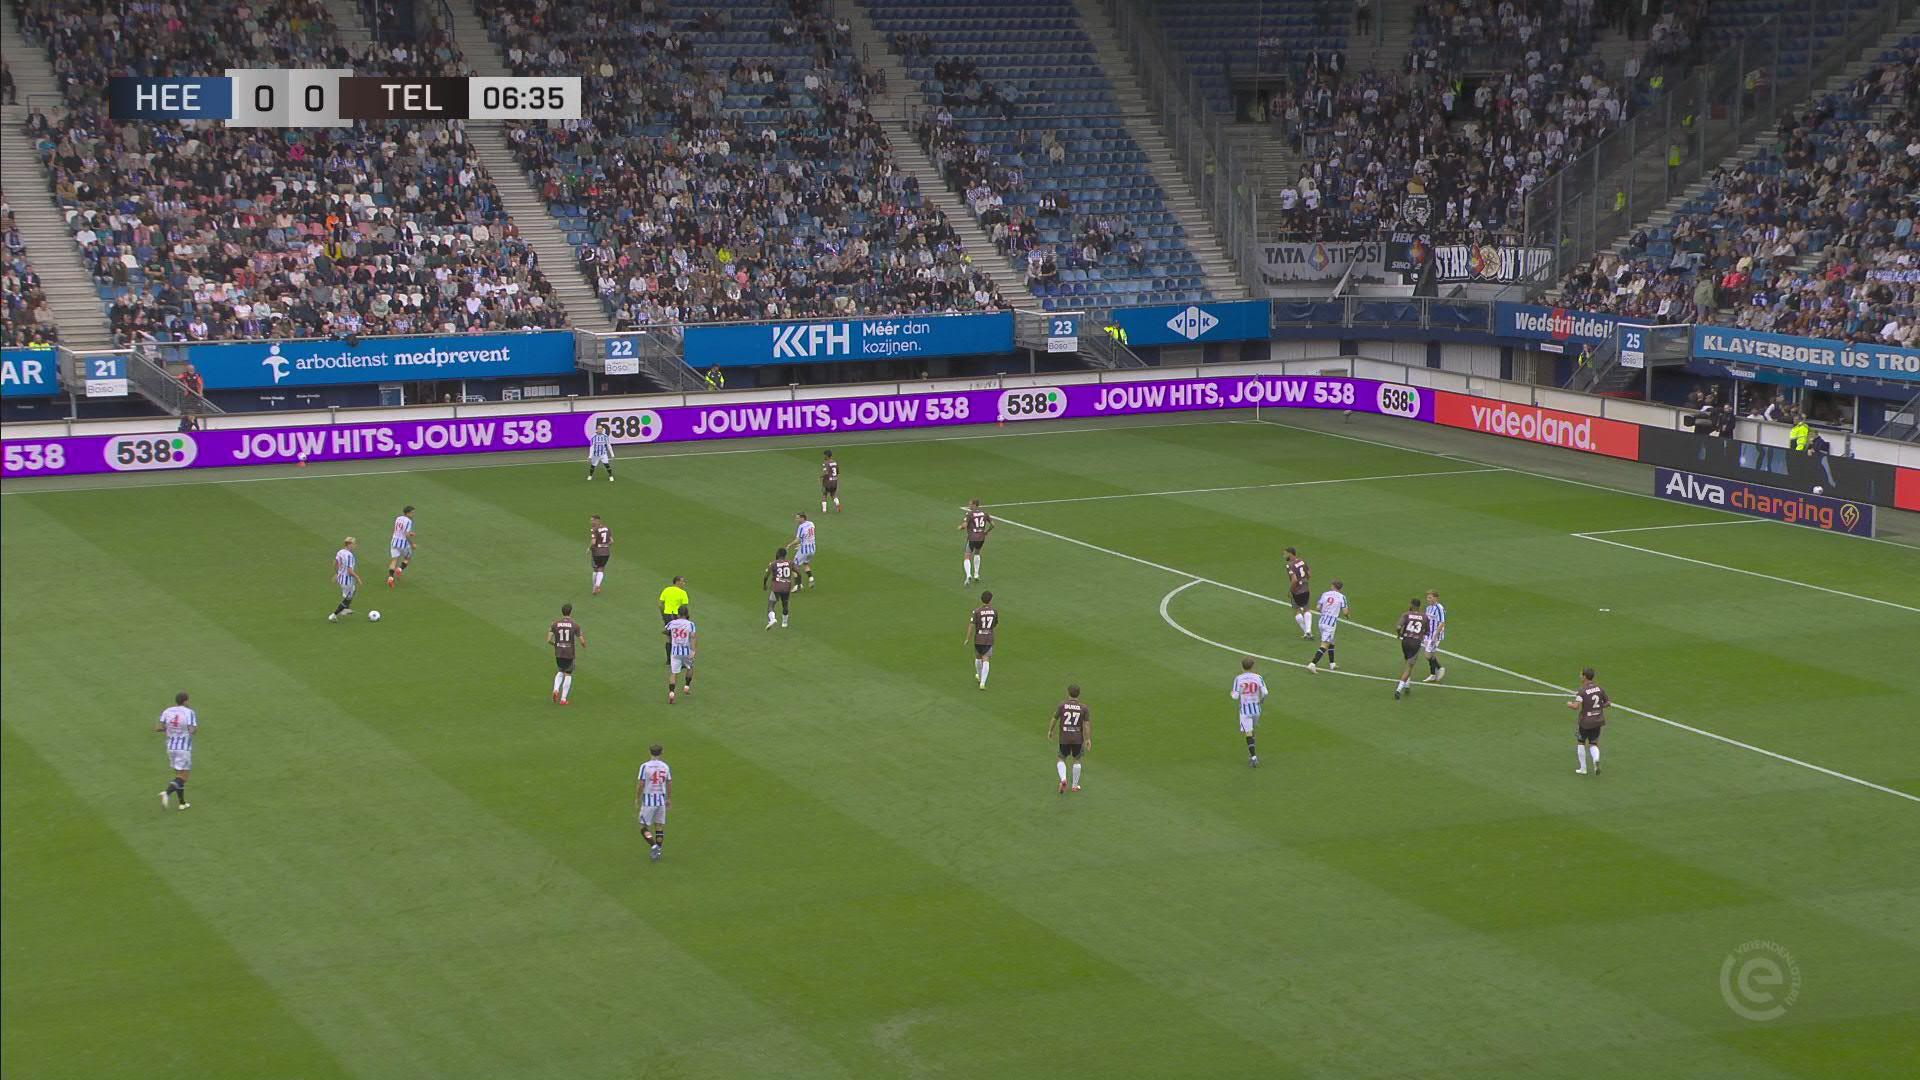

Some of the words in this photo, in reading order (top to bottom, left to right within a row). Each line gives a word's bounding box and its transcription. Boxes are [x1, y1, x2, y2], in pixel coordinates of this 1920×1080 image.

[1264, 247, 1306, 265] TATA
[1328, 242, 1382, 264] TIFOSI
[862, 321, 900, 337] Méér
[903, 320, 931, 335] dan
[1054, 320, 1073, 335] 23
[1174, 317, 1211, 329] VDK
[611, 341, 632, 356] 22
[772, 323, 850, 358] KKFH
[862, 339, 922, 355] kozijnen.
[1626, 333, 1641, 349] 25
[295, 352, 388, 370] arbodienst
[394, 346, 511, 368] medprevent
[1703, 335, 1835, 366] KLAVERBOER
[1841, 348, 1870, 369] ÚS
[1876, 353, 1920, 373] TRO
[1, 359, 44, 385] AR
[93, 360, 117, 377] 21
[1006, 393, 1048, 416] 538
[1094, 385, 1167, 412] JOUW
[1171, 382, 1224, 407] HITS,
[1229, 380, 1308, 403] JOUW
[1313, 381, 1355, 405] 538
[1382, 388, 1409, 412] 538
[692, 408, 773, 435] JOUW
[776, 404, 838, 430] HITS,
[842, 400, 920, 427] JOUW
[925, 397, 970, 420] 538
[596, 415, 641, 439] 538
[1471, 403, 1597, 450] videoland.
[232, 431, 326, 460] JOUW
[332, 427, 402, 456] HITS,
[408, 422, 496, 450] JOUW
[502, 419, 553, 446] 538
[4, 443, 66, 472] 538
[117, 439, 171, 465] 538
[1665, 472, 1725, 505] Alva
[1730, 488, 1834, 530] charging
[777, 567, 791, 578] 30
[1327, 597, 1335, 606] 9
[981, 616, 994, 629] 17
[558, 629, 570, 641] 11
[672, 628, 688, 639] 36
[1241, 682, 1258, 695] 20
[1591, 695, 1600, 709] 2
[1063, 711, 1081, 726] 27
[650, 770, 666, 785] 45
